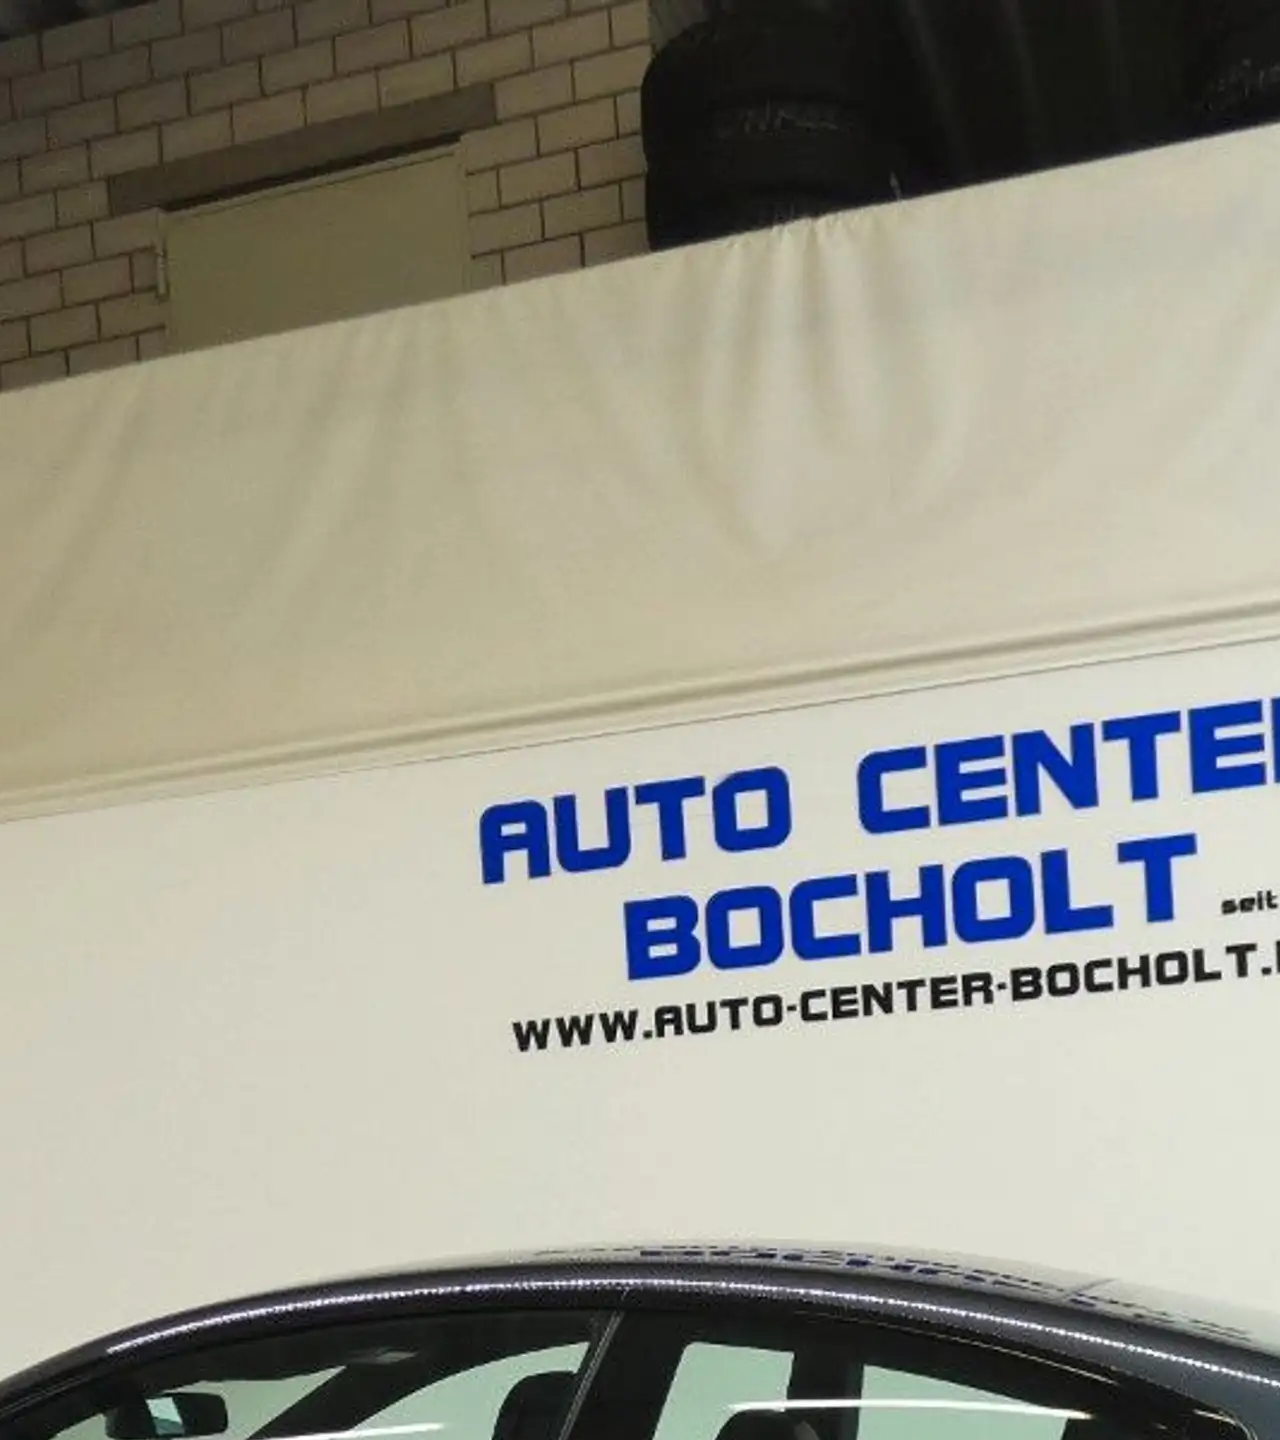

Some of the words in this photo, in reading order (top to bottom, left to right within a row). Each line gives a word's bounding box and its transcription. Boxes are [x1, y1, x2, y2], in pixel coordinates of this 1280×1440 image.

[480, 768, 793, 884] AUTO
[625, 833, 1198, 981] BOCHOLT
[1221, 889, 1279, 916] seit
